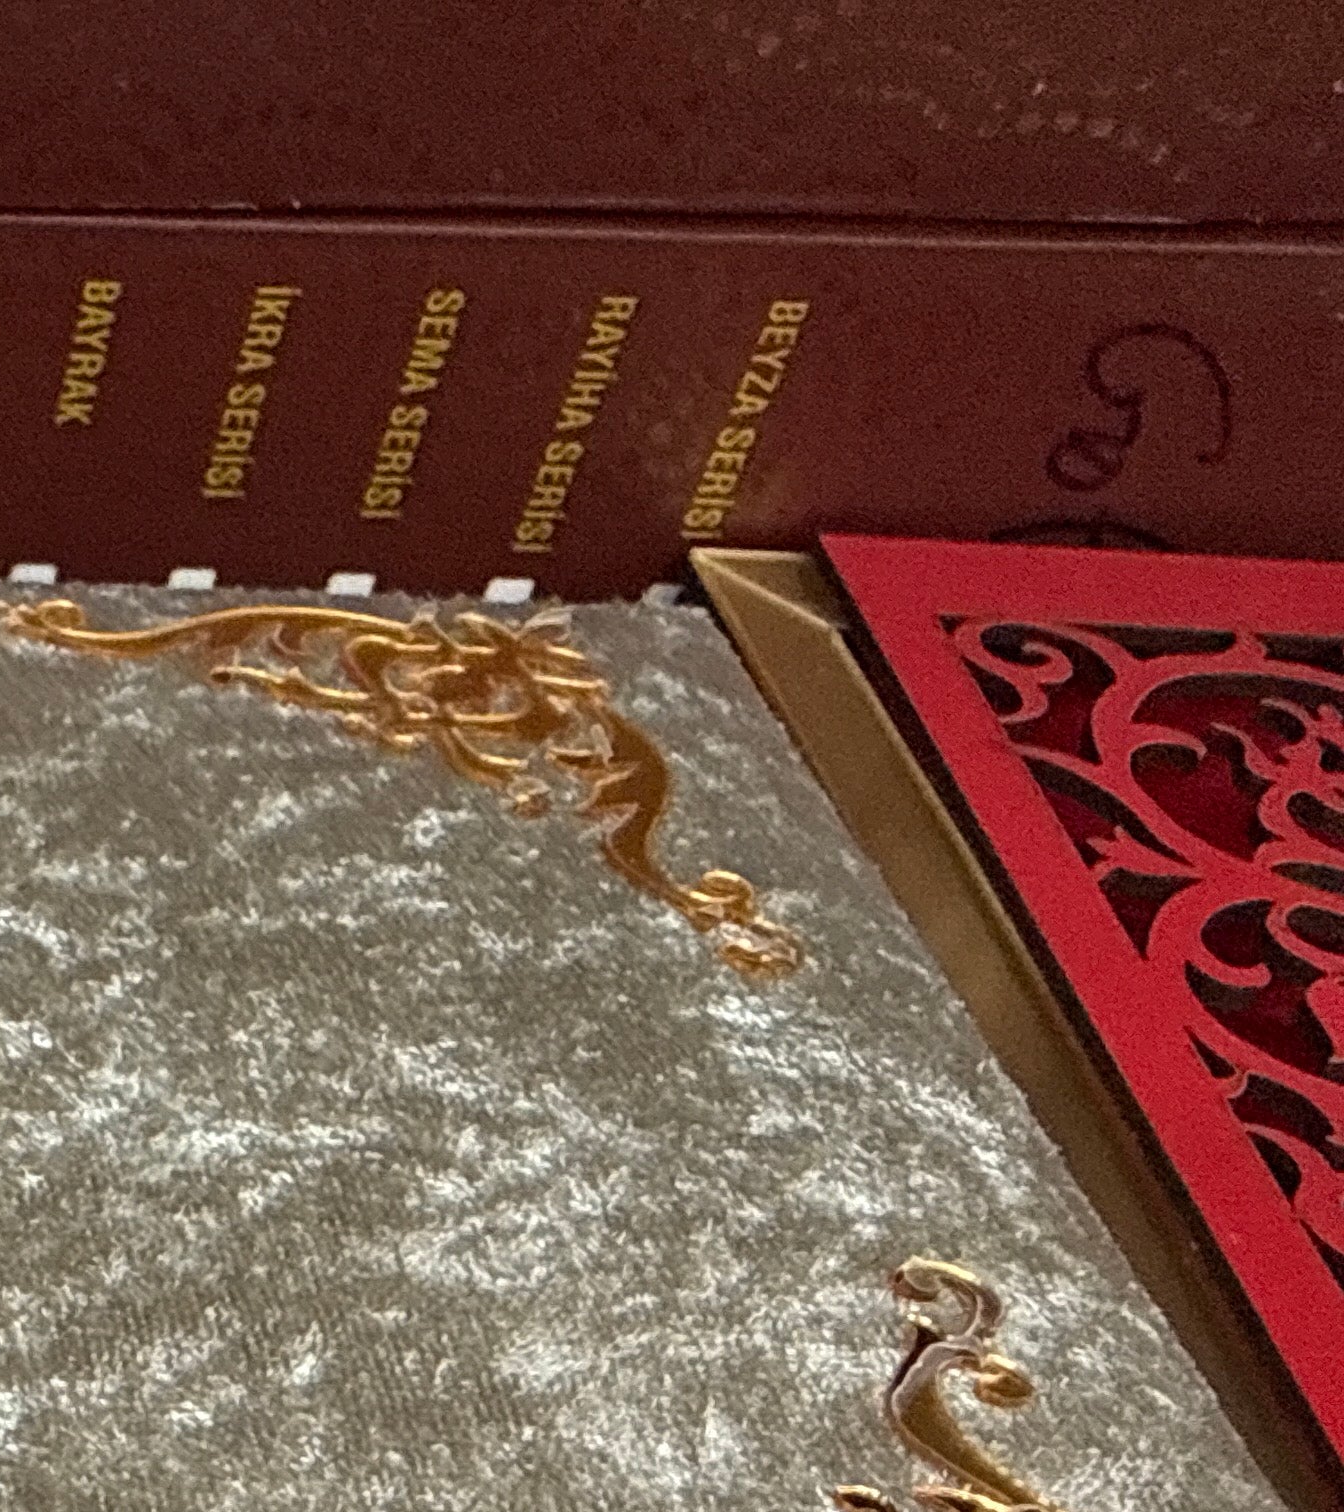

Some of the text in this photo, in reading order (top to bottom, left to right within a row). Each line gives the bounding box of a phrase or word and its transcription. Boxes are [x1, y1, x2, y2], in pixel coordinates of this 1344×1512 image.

[54, 280, 123, 427] BAYRAK
[399, 289, 465, 396] SEMA
[727, 300, 810, 417] BEYZA
